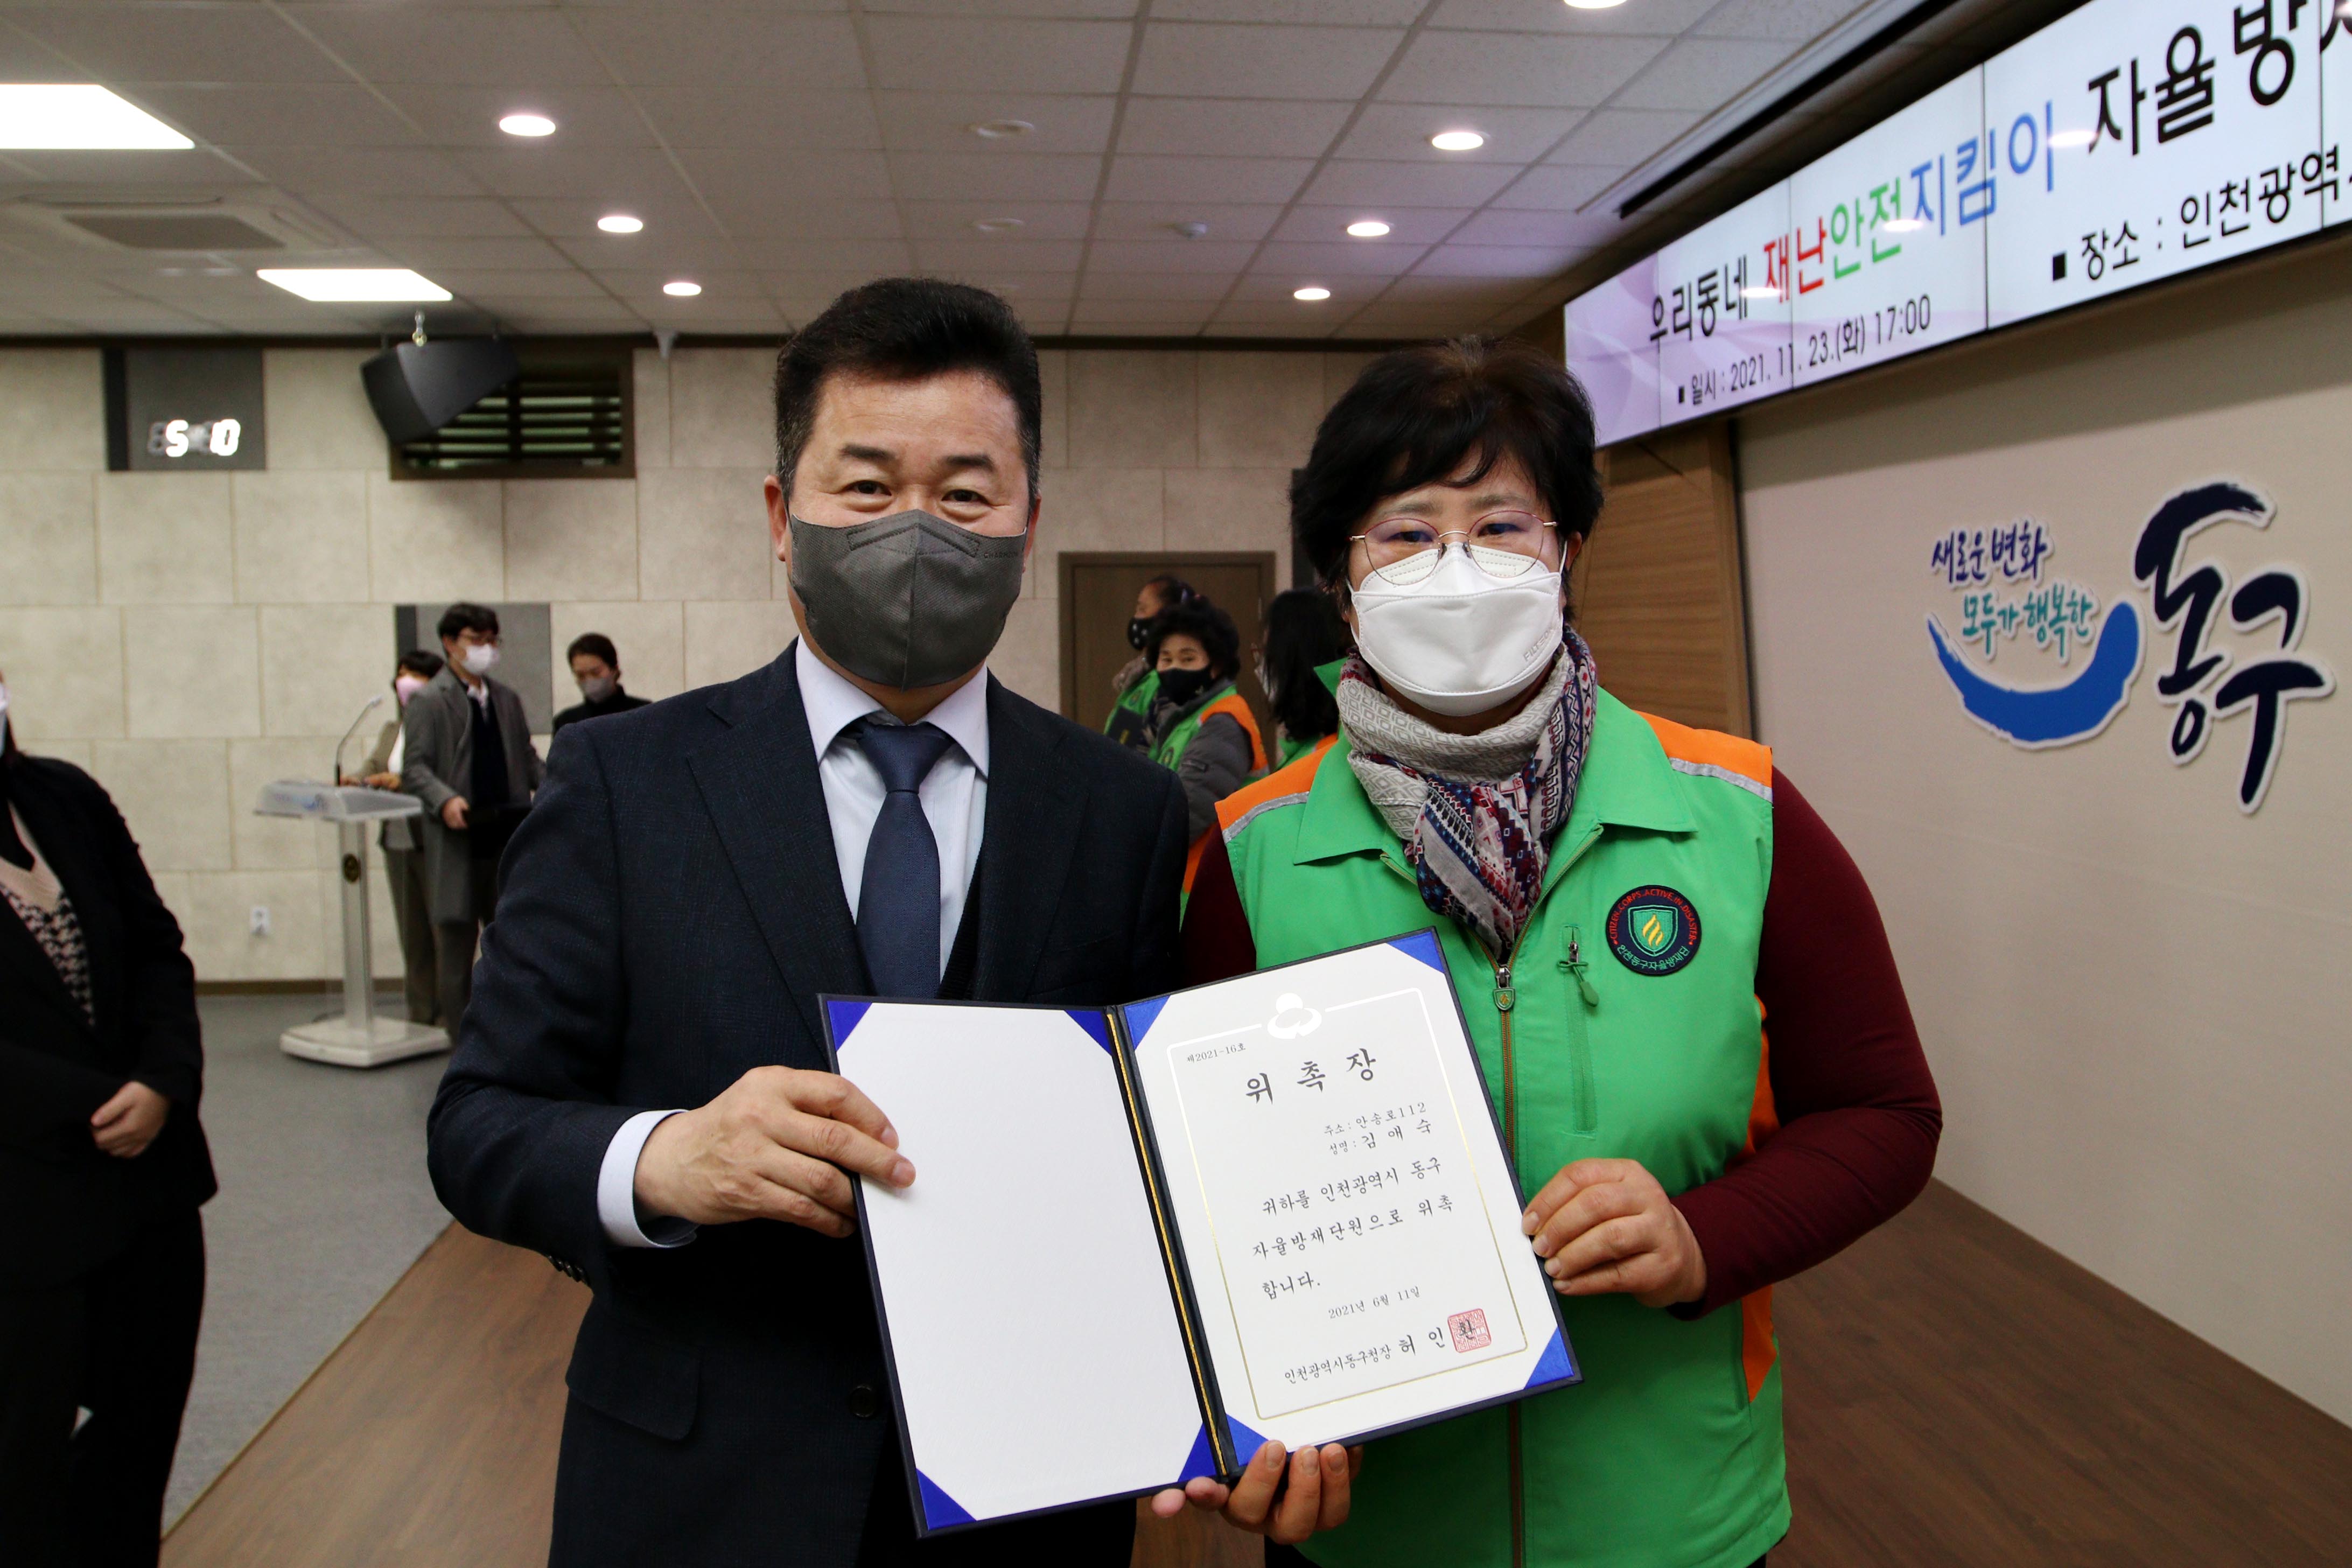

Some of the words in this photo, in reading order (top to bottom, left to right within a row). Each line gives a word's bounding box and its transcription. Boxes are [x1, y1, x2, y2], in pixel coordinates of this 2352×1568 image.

[1650, 254, 1748, 351] 우리동네
[1763, 101, 2054, 304] 재난안전지킴이
[2081, 220, 2143, 281] 장소
[2179, 143, 2352, 250] 인천광역
[1692, 368, 1716, 405] 일시
[1731, 353, 1771, 392] 2021.
[1875, 293, 1931, 345] 17:00
[1932, 530, 1986, 584] 새로운
[1992, 520, 2048, 580] 변화
[1963, 592, 2020, 655] 모두가
[2023, 582, 2093, 657] 행복한
[2134, 482, 2325, 805] 동구
[1262, 1189, 1310, 1216] 귀하를
[1320, 1167, 1399, 1202] 인천광역시
[1411, 1157, 1441, 1180] 동구
[1252, 1209, 1404, 1261] 자율방재단원으로
[1418, 1194, 1453, 1217] 위촉
[1262, 1271, 1321, 1300] 합니다.
[1328, 1300, 1366, 1319] 2021년
[1373, 1293, 1390, 1307] 6월
[1397, 1285, 1420, 1301] 11일
